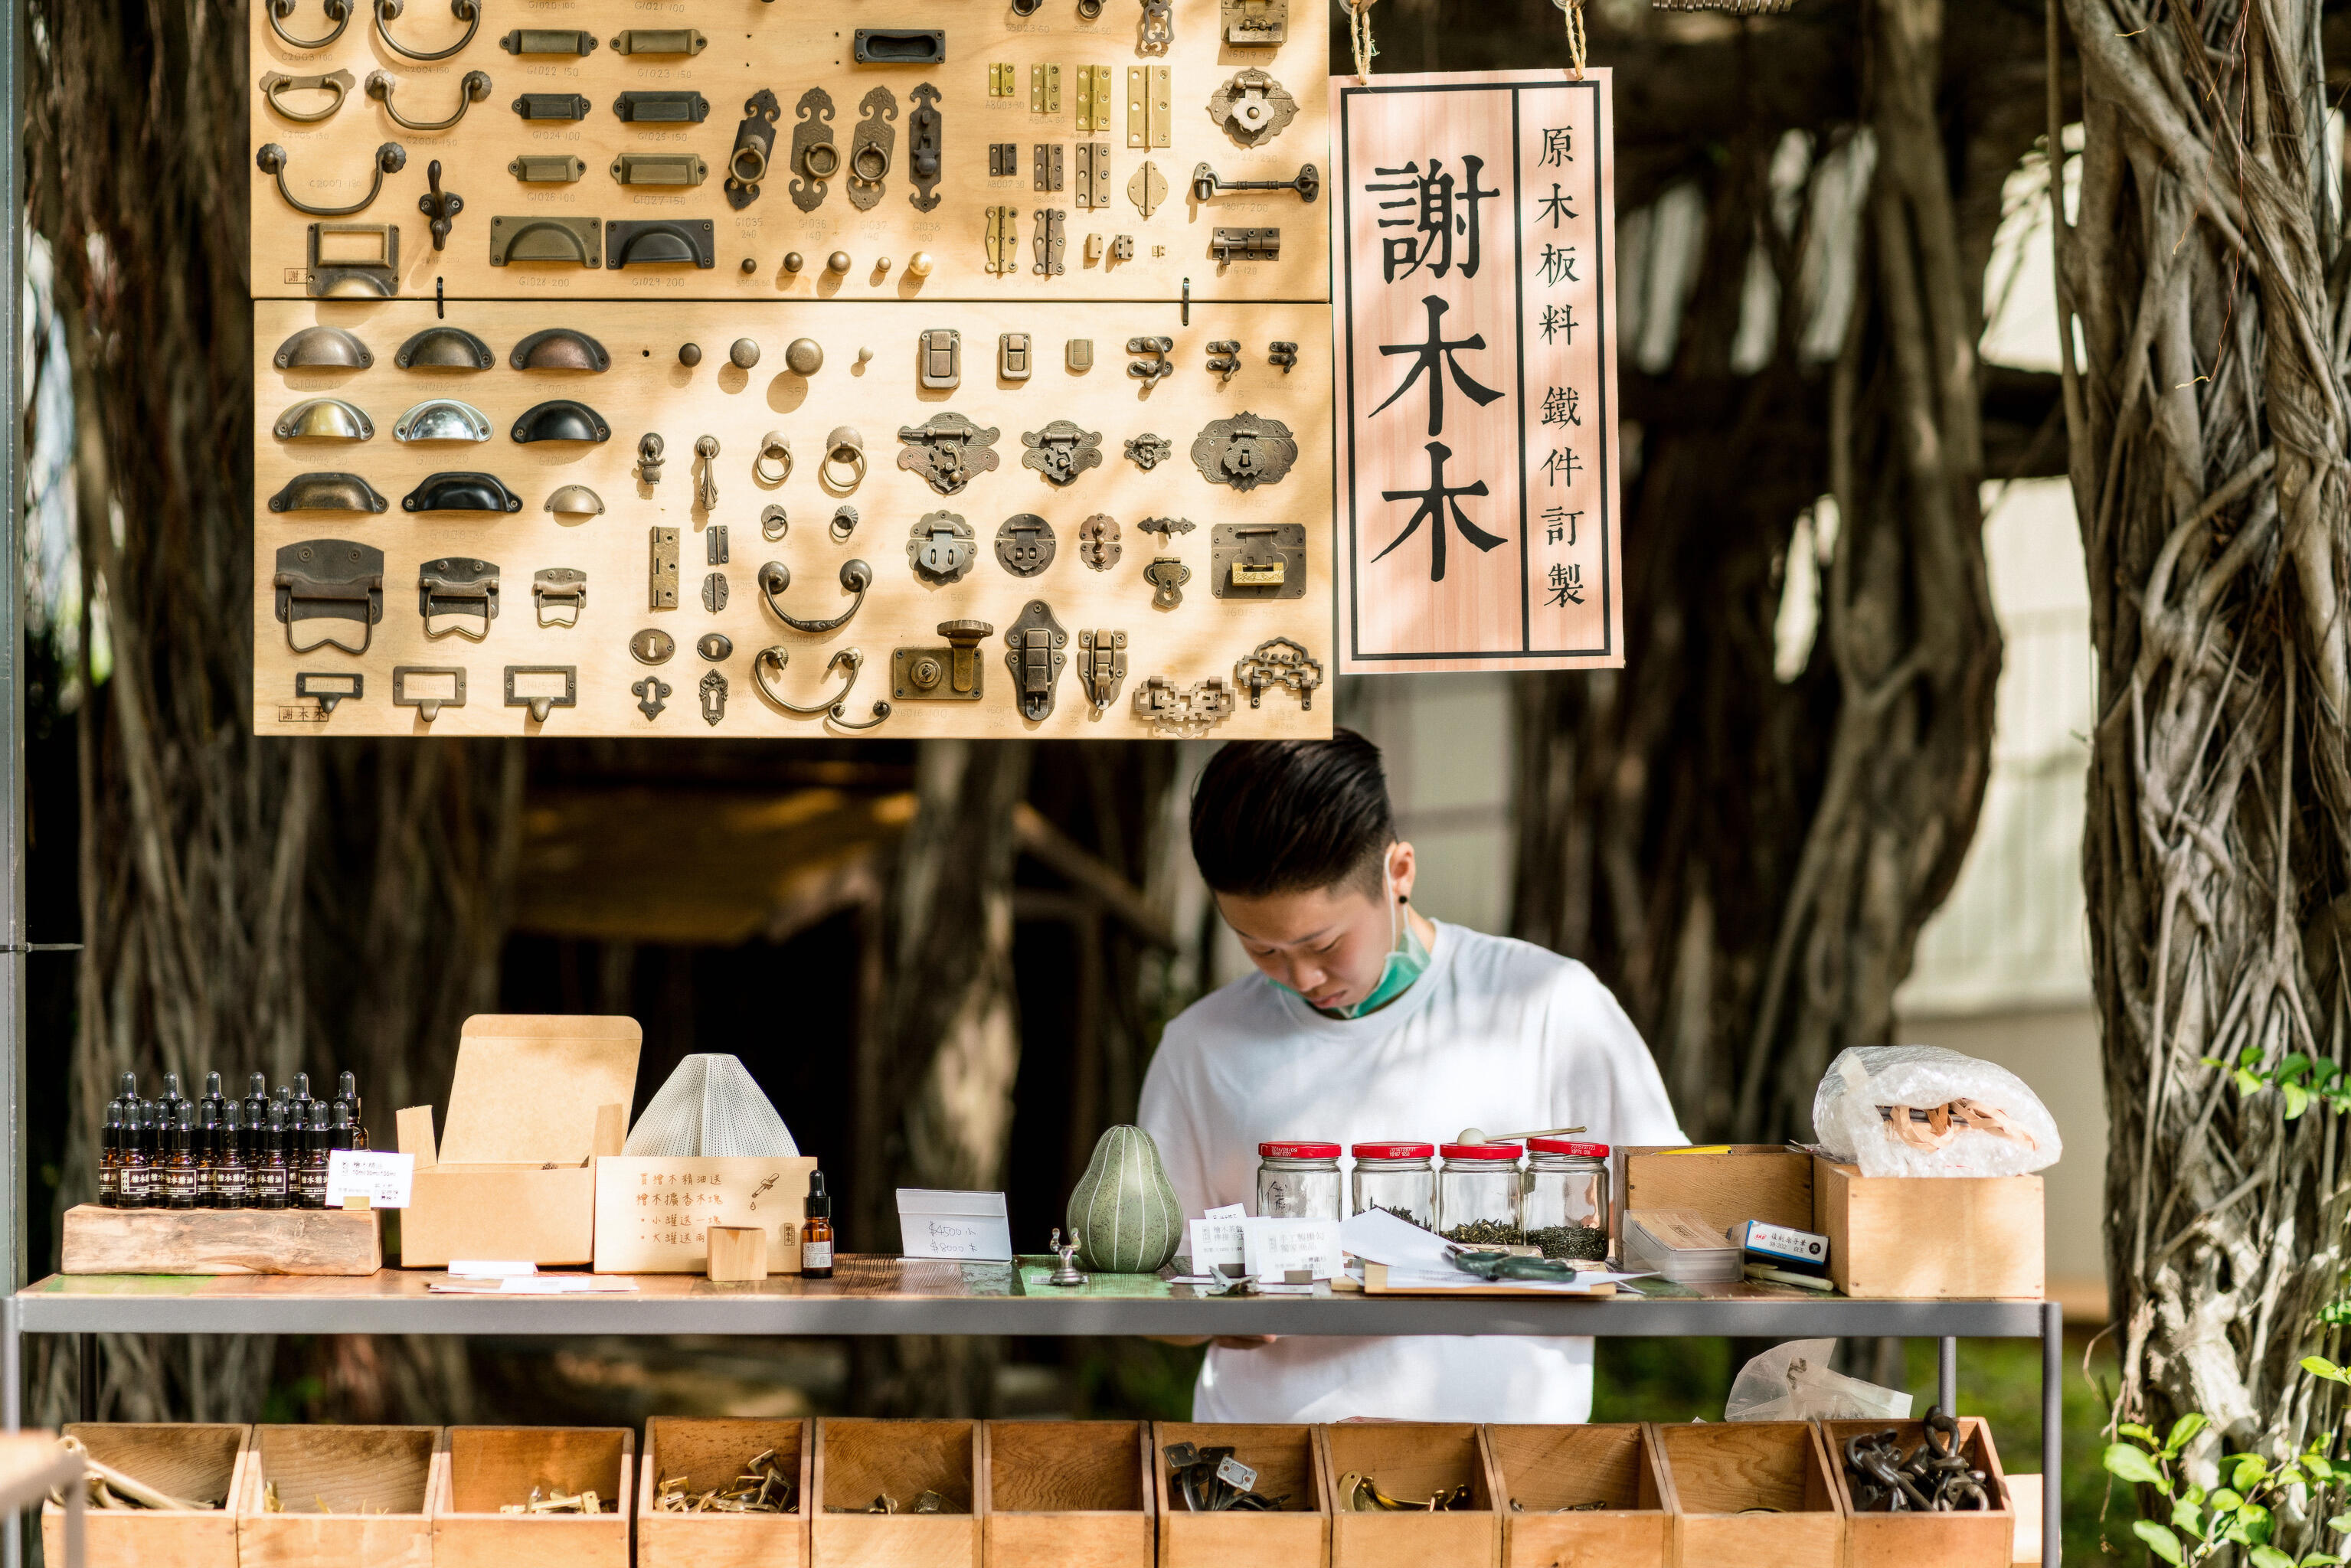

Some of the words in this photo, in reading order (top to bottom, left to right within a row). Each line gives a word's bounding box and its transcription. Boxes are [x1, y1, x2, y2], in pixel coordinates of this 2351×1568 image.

[1535, 126, 1580, 345] 原木板料
[1365, 155, 1508, 582] 謝木木
[1540, 386, 1585, 608] 鐵件訂製
[928, 1220, 962, 1237] $4500
[929, 1240, 964, 1253] $8000
